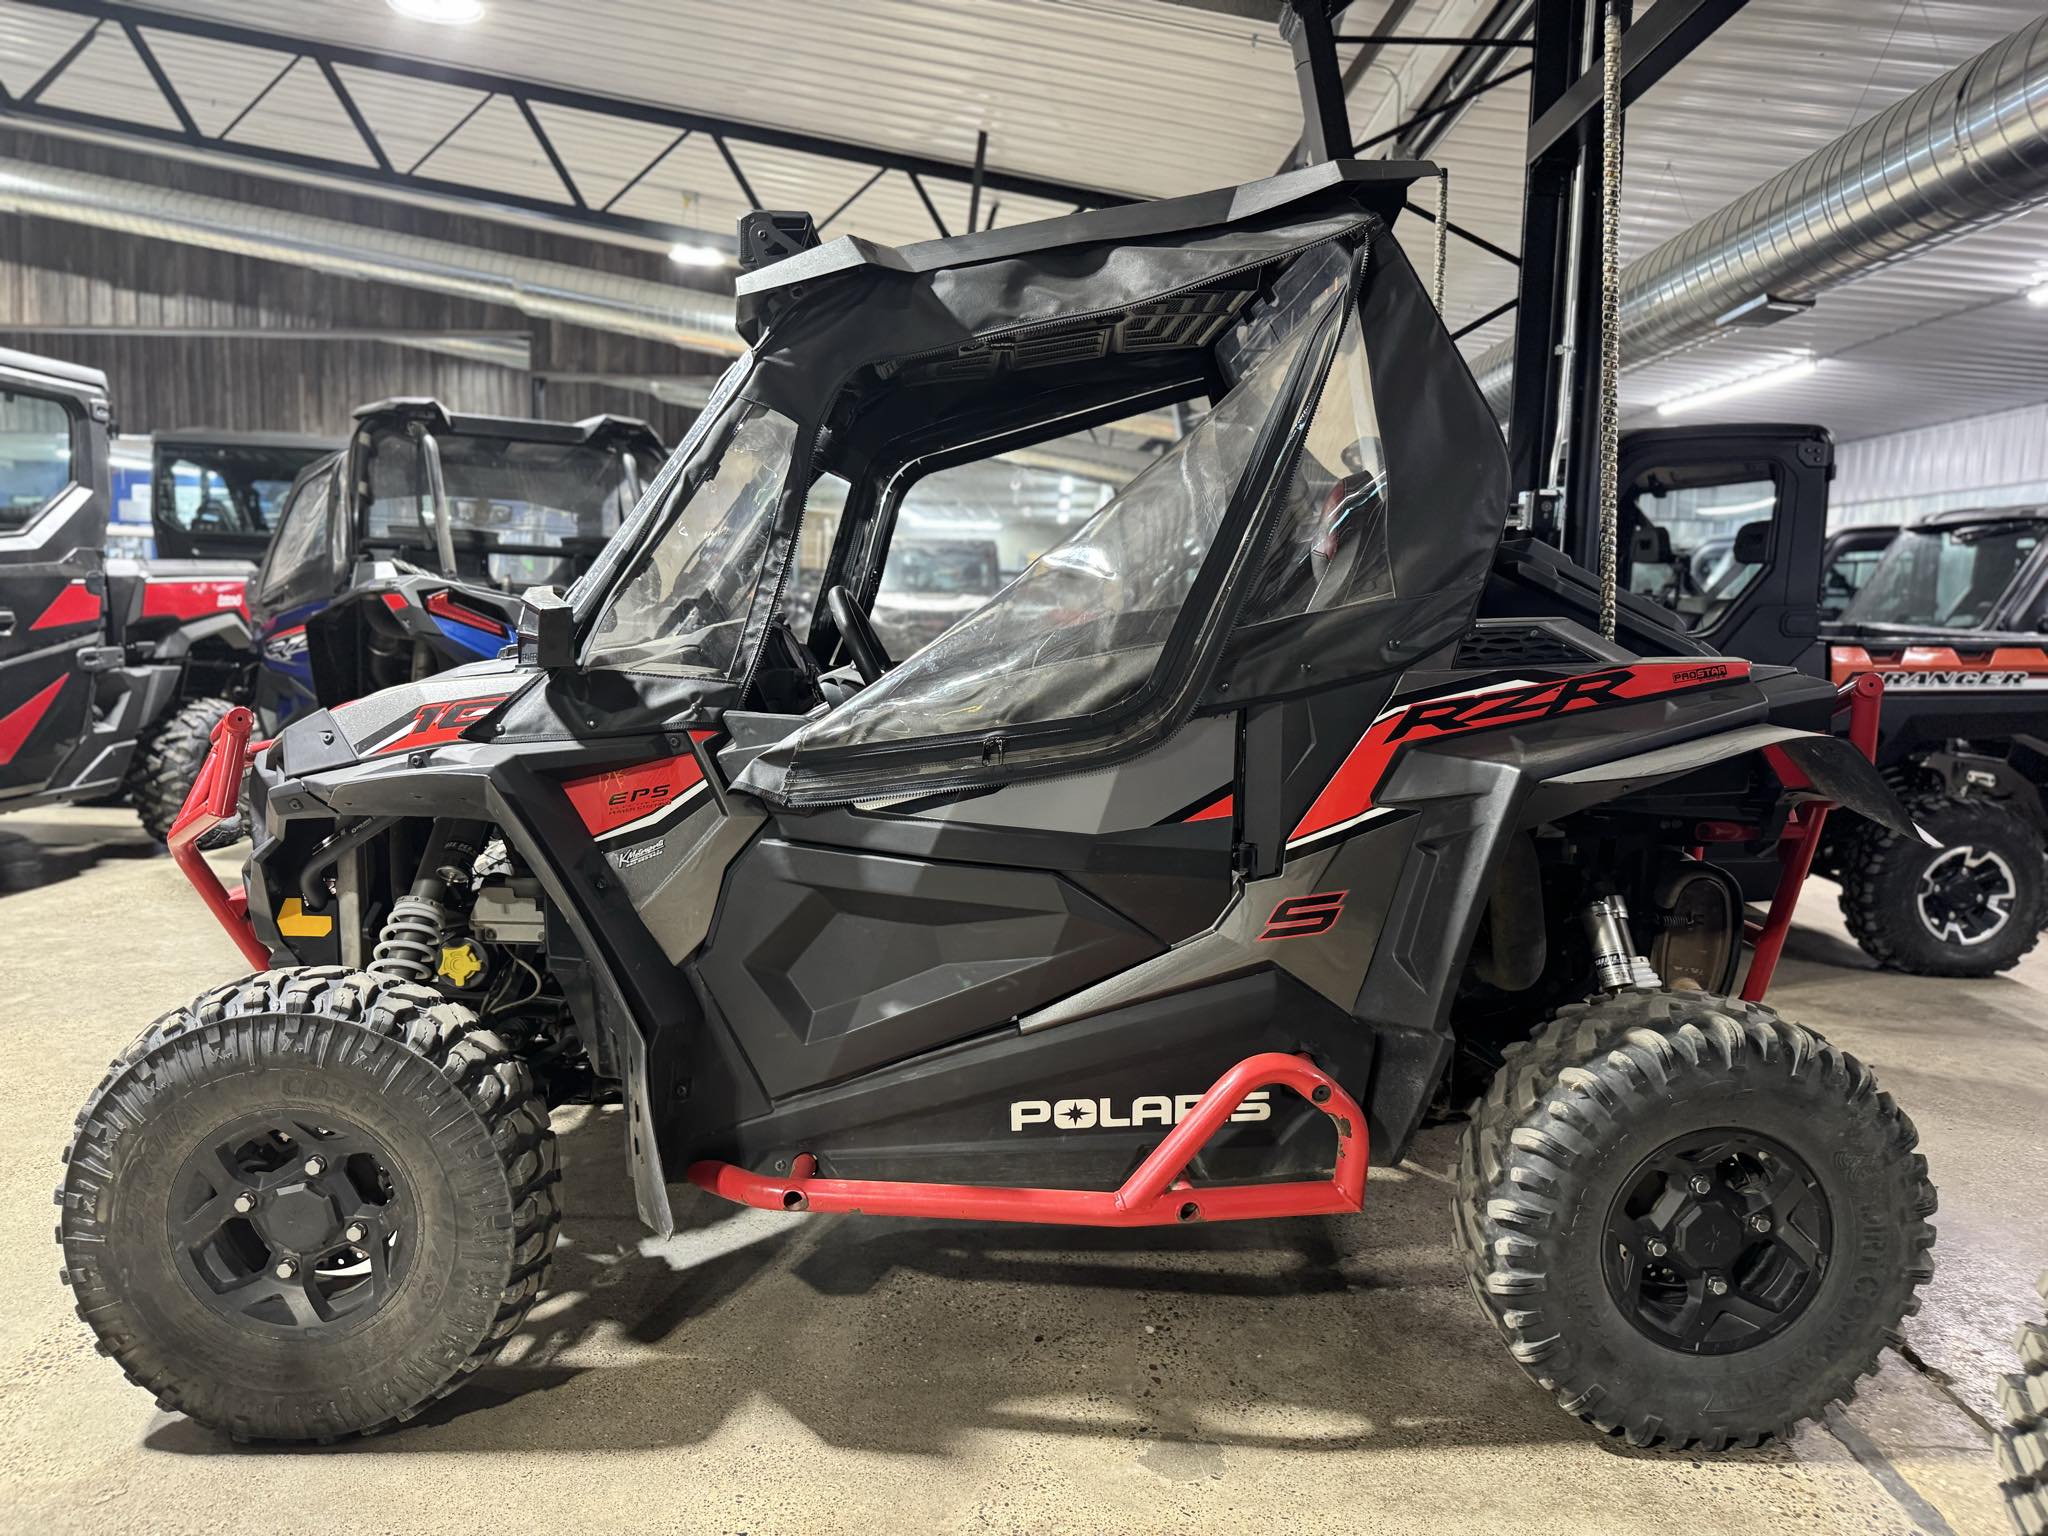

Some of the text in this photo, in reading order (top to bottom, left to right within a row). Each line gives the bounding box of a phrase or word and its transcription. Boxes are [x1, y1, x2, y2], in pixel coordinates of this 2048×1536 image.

[1673, 665, 1727, 682] PROSTAR
[1883, 671, 2029, 688] RANGER
[1382, 670, 1637, 745] RZR
[608, 783, 671, 806] EPS
[1256, 890, 1349, 942] S
[1010, 1092, 1271, 1131] POLAS
